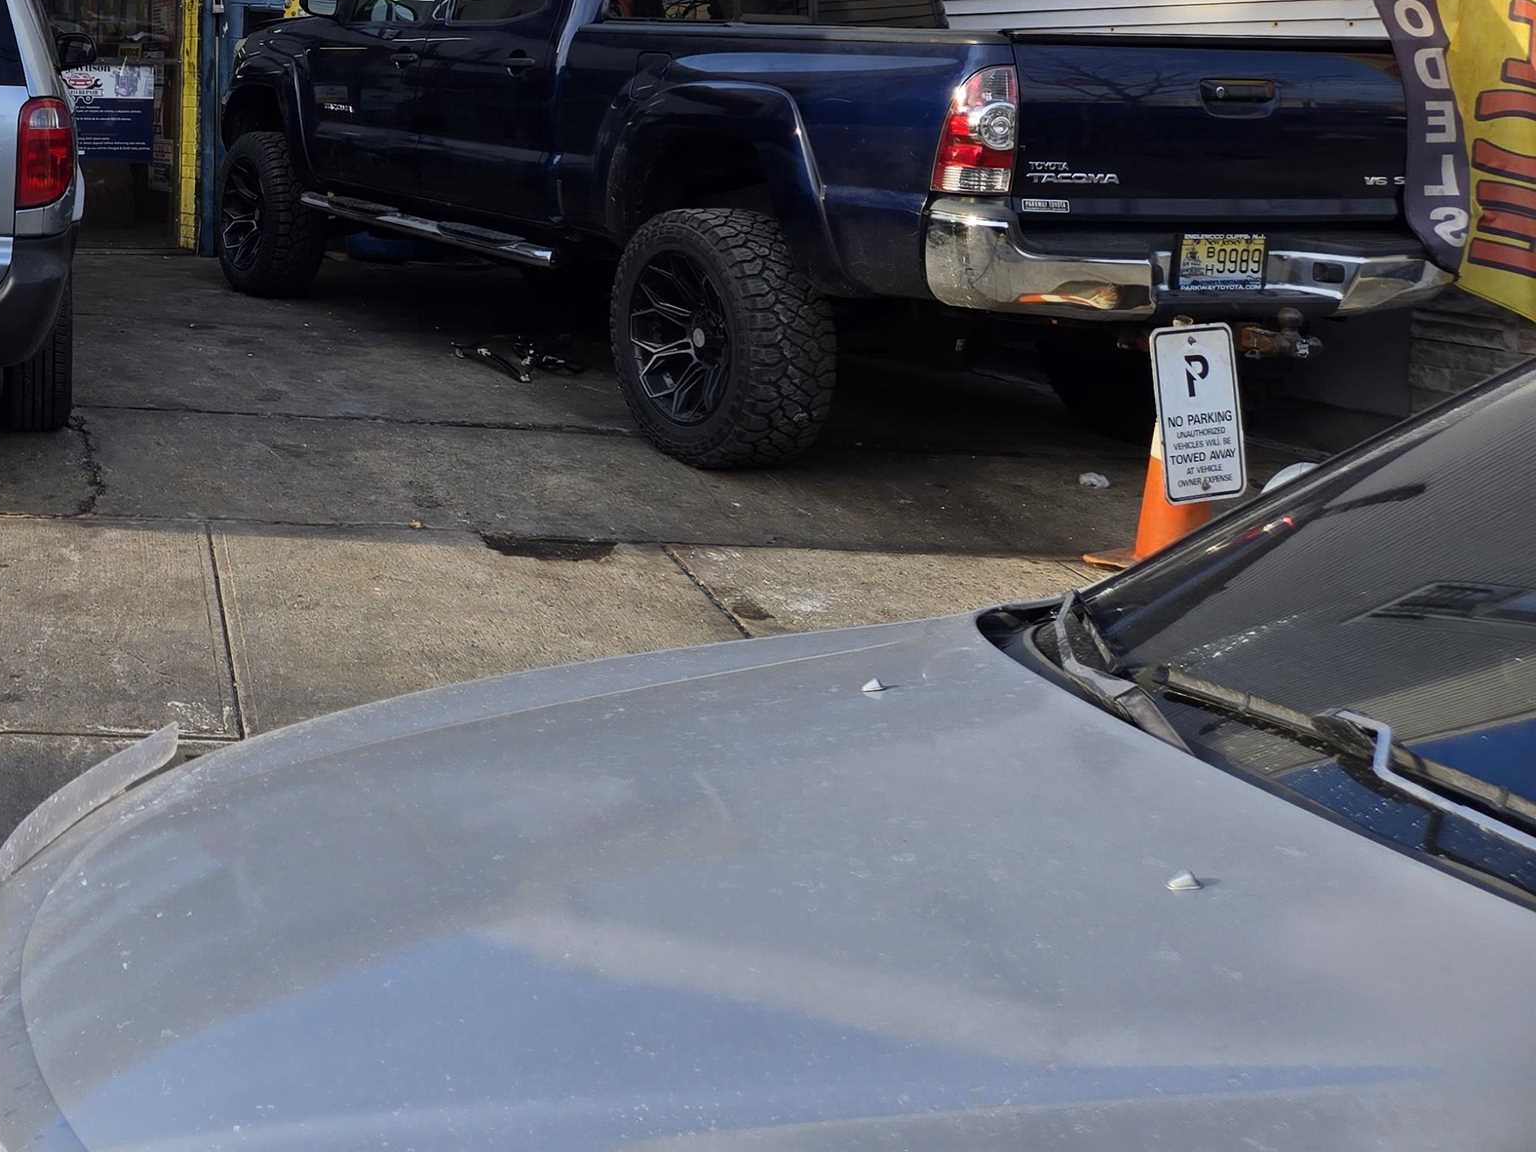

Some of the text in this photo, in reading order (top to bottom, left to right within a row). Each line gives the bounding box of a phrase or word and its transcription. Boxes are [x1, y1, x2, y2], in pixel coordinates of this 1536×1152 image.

[1028, 161, 1069, 171] TOYOTA
[1025, 172, 1120, 184] TACOMA
[1167, 410, 1233, 428] NO PARKING
[1176, 426, 1226, 439] UNAUTHORIZED
[1173, 436, 1231, 450] VEHICLES WILL BE
[1169, 447, 1236, 465] TOWED AWAY
[1186, 463, 1223, 475] AT VEHICLE
[1177, 477, 1202, 488] OWNER
